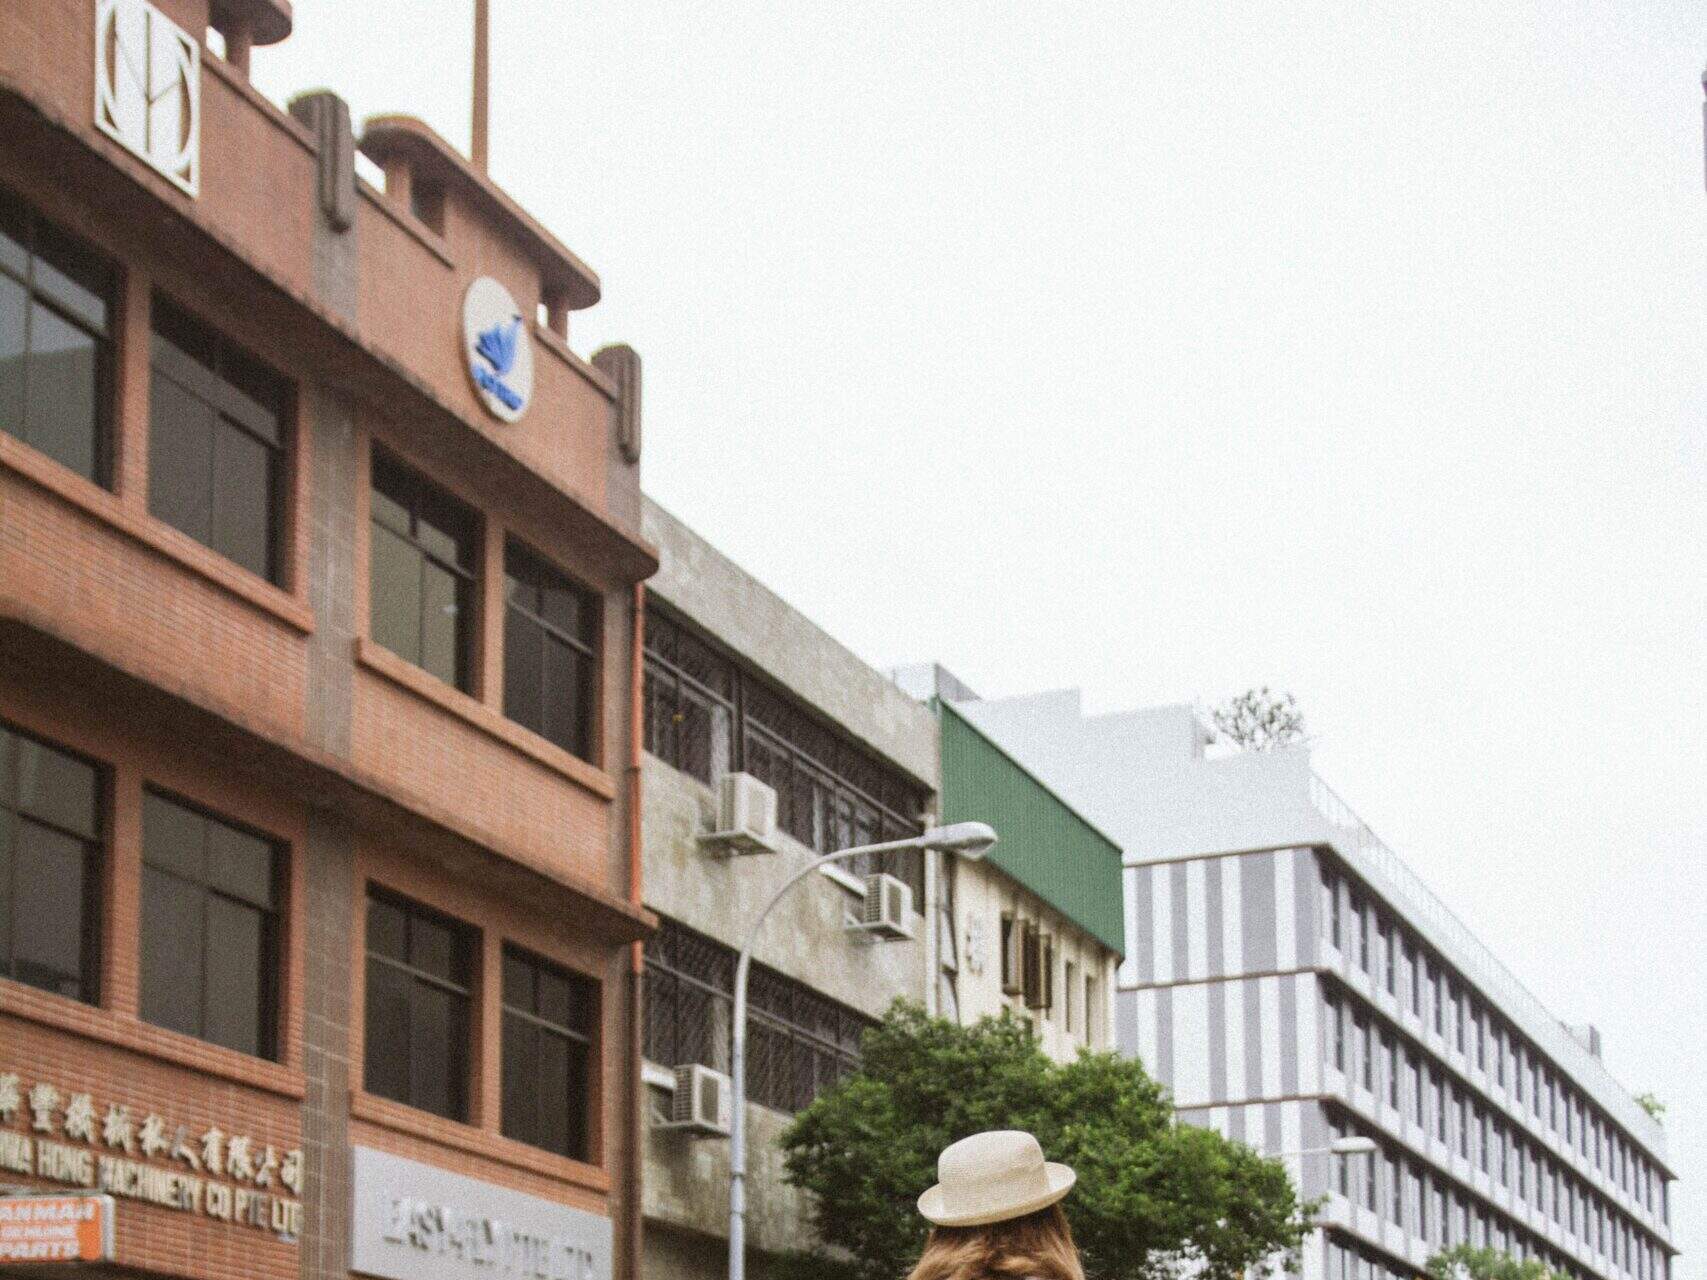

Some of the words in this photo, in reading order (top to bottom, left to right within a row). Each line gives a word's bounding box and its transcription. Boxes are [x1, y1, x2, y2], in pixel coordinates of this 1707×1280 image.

[37, 1138, 94, 1187] HONG
[99, 1154, 201, 1212] MACHINERY
[206, 1180, 232, 1223] CO
[235, 1187, 268, 1229] PTE
